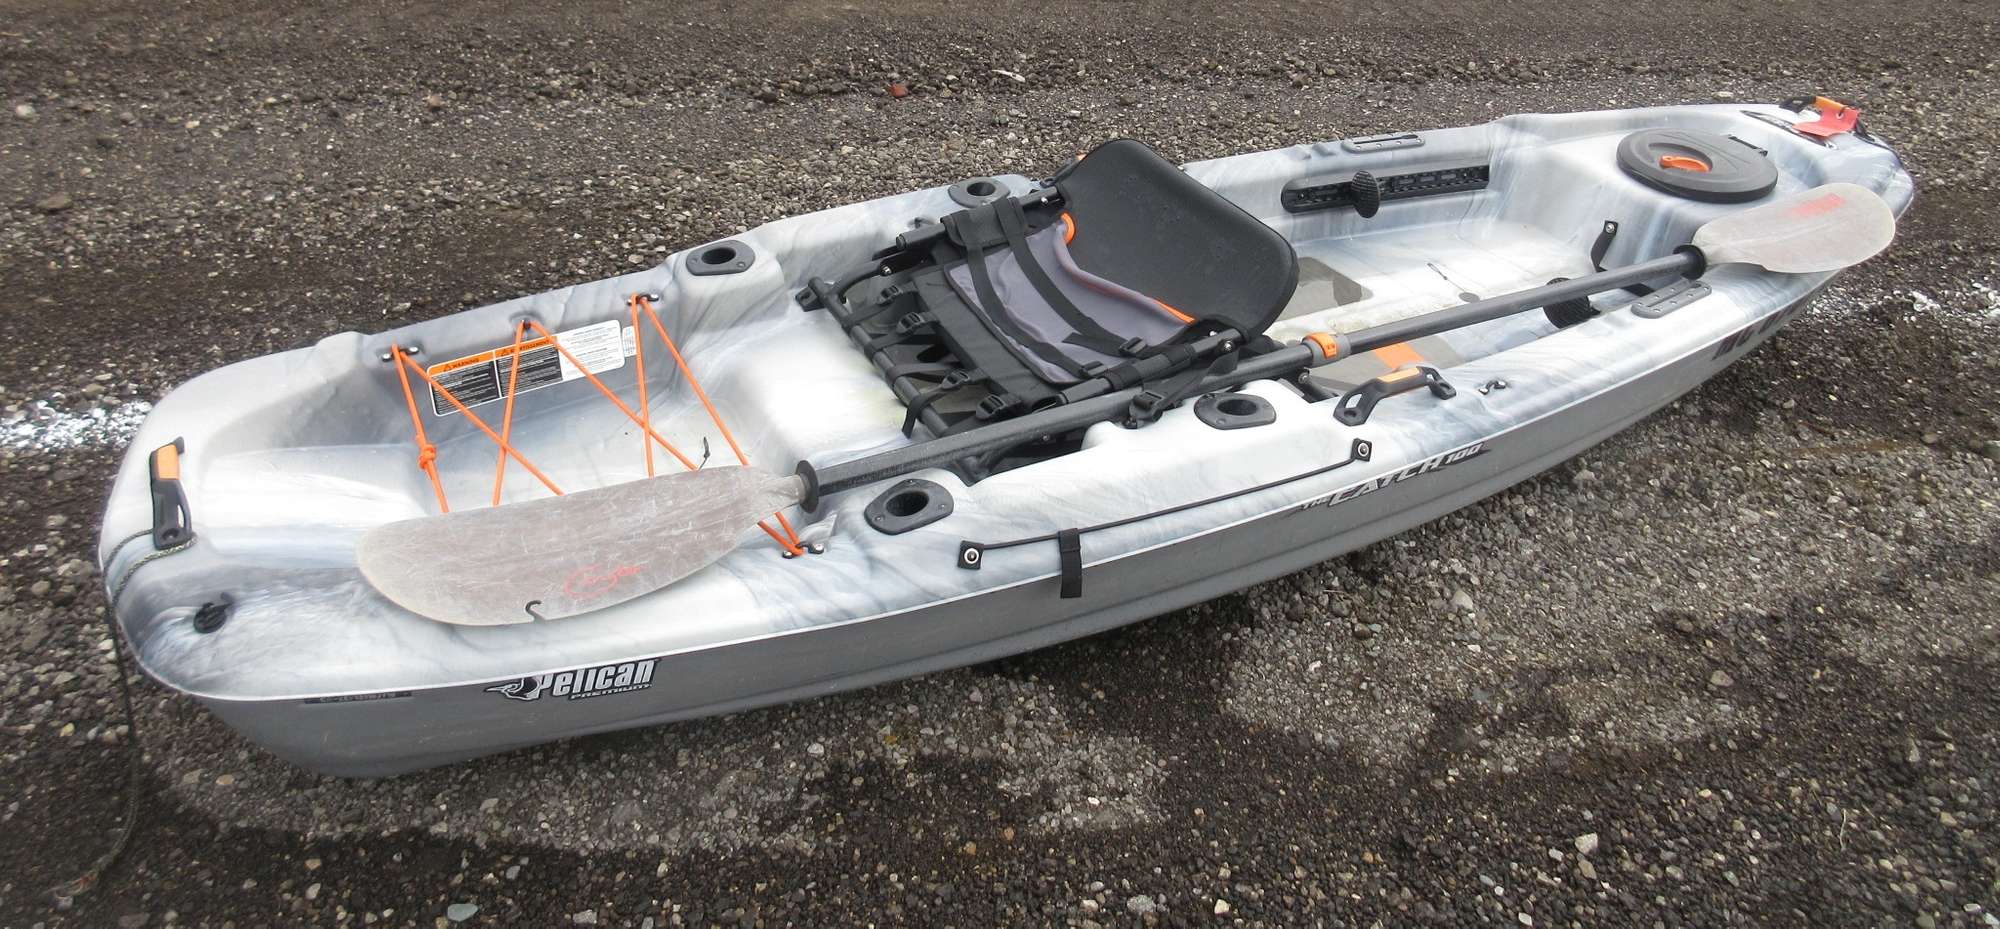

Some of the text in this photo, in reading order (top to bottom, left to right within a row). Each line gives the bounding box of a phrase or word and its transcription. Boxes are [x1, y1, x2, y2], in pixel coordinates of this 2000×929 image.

[450, 357, 479, 369] WARNING
[1303, 443, 1484, 509] THE CATCH 100
[571, 684, 652, 699] PREMIUM
